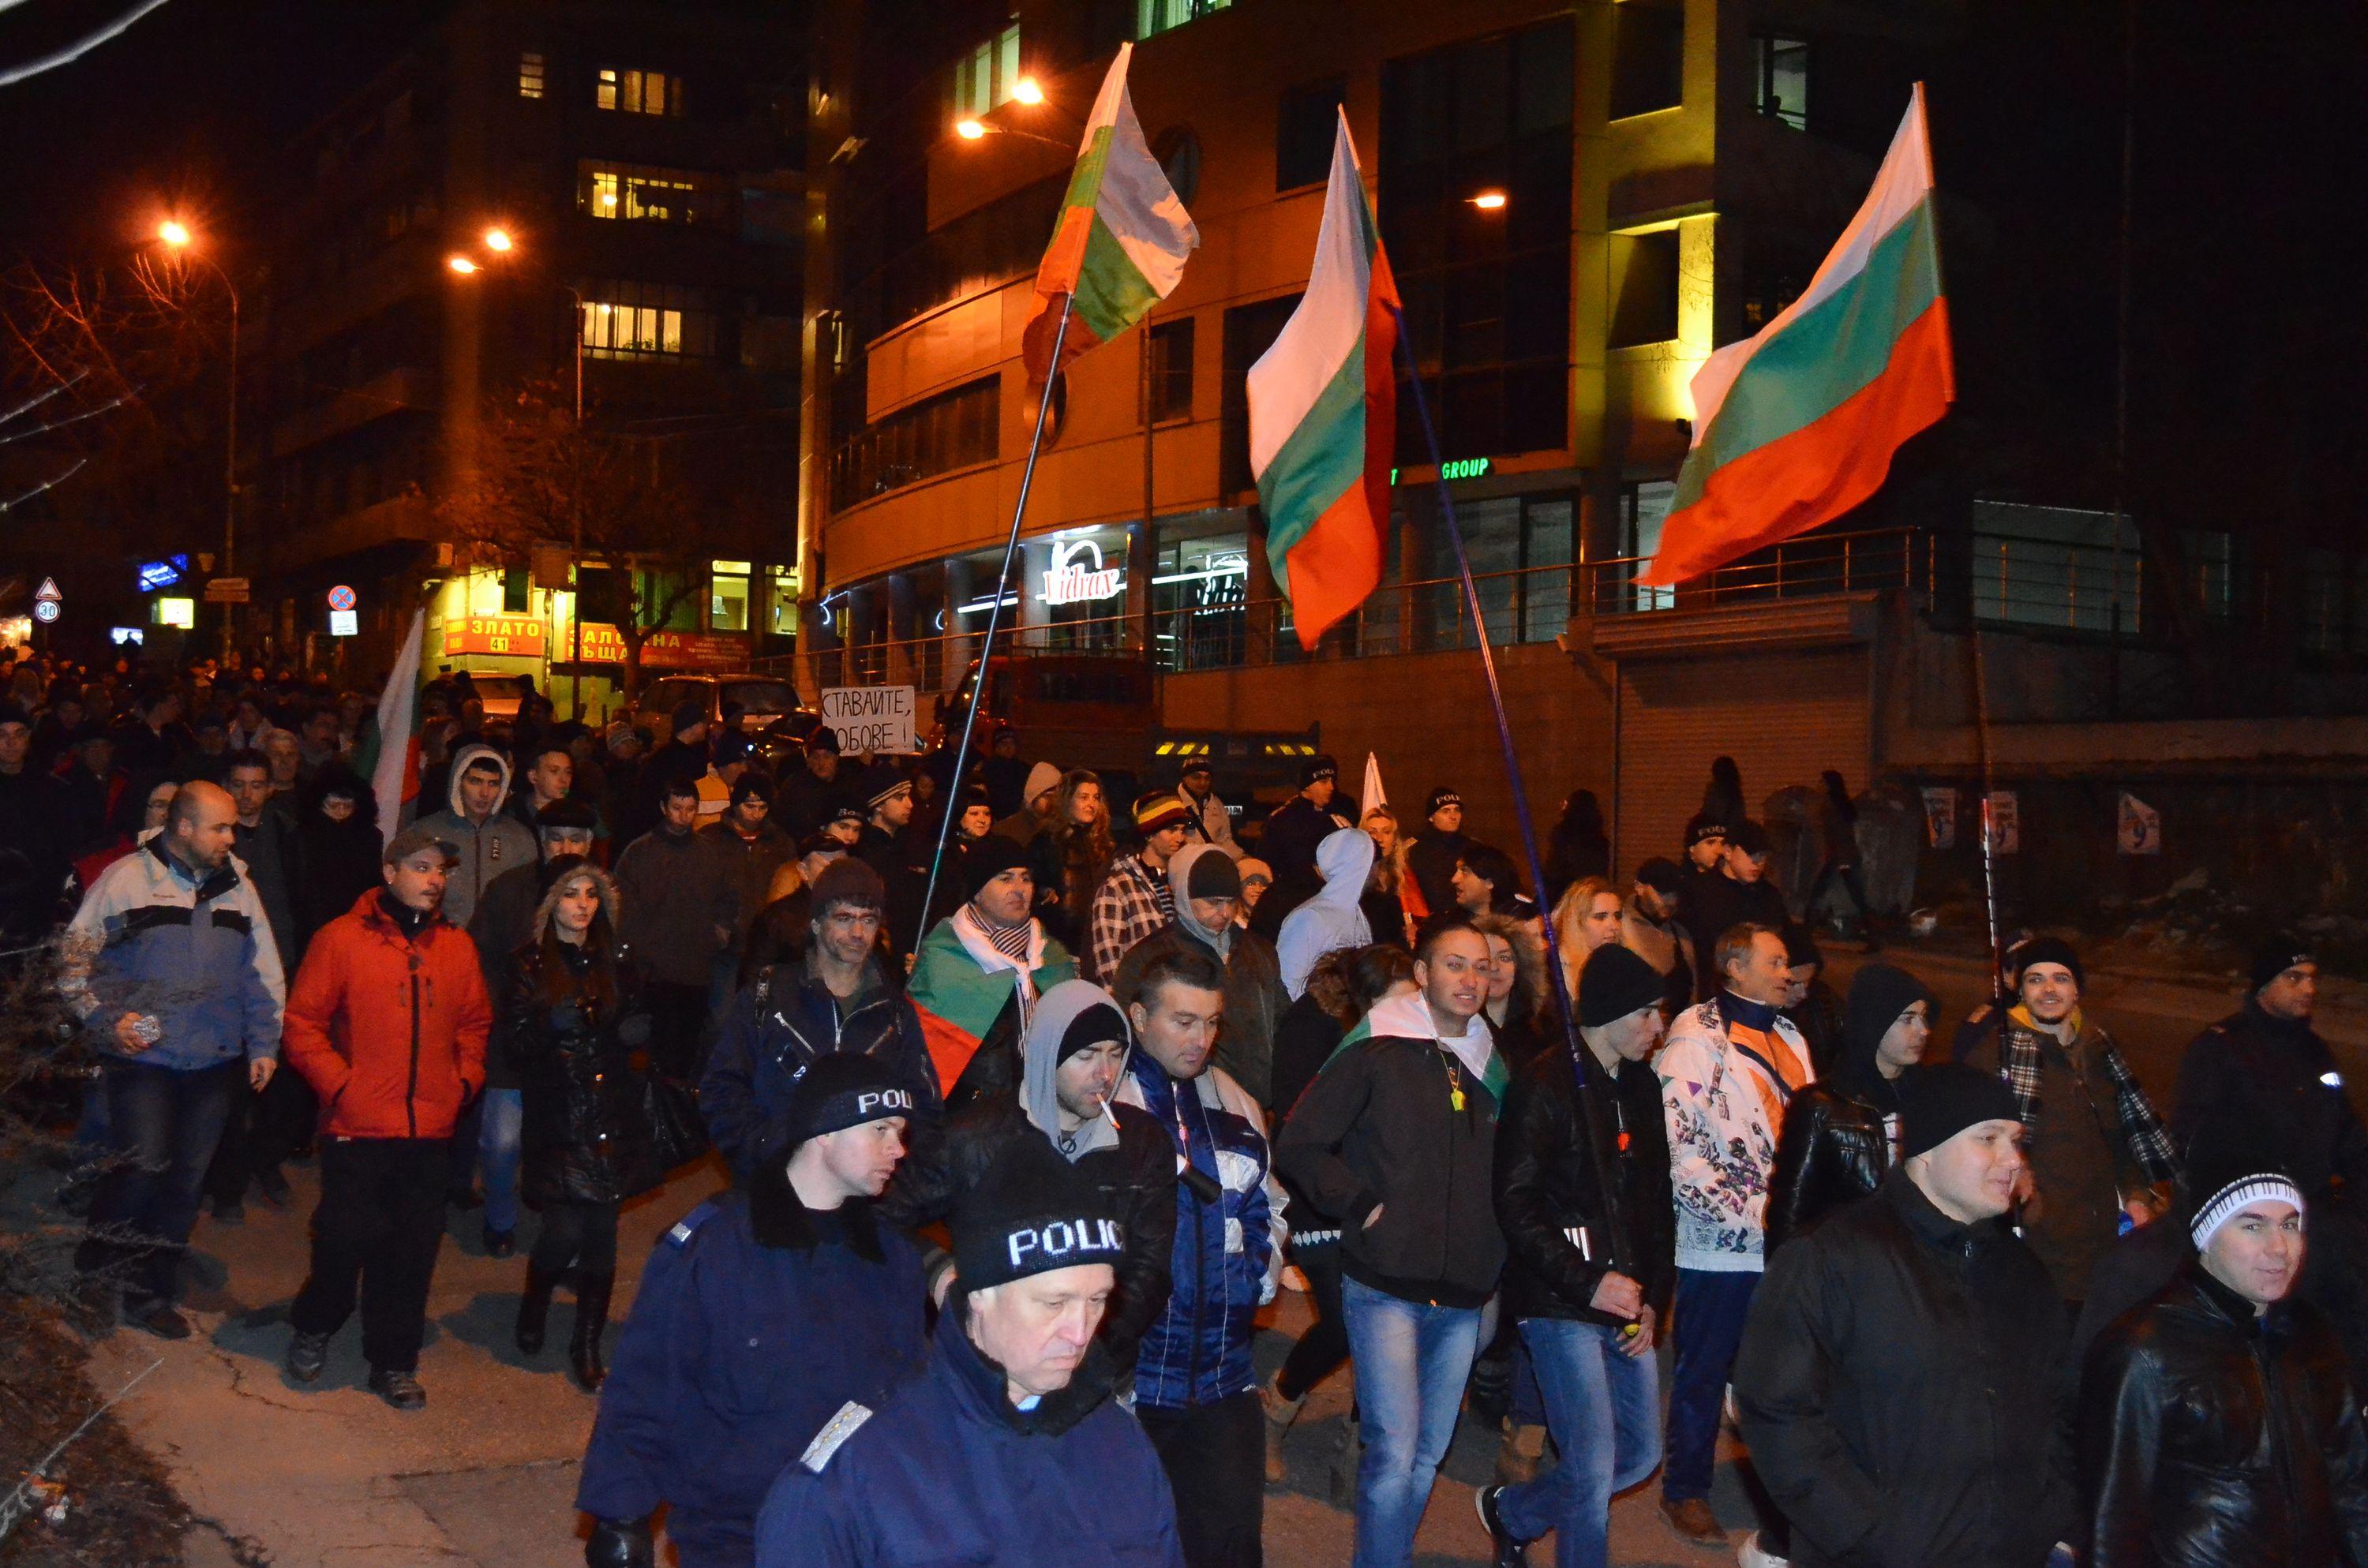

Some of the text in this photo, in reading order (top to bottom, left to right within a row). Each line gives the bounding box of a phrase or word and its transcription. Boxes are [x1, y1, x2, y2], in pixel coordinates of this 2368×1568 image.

[1441, 457, 1489, 480] GROUP
[40, 604, 56, 617] 30
[471, 619, 540, 637] ЗЛАТО
[568, 628, 681, 648] АЛОНА
[492, 638, 507, 651] 41
[822, 689, 912, 717] СТАВАЙТЕ,
[836, 722, 894, 751] ОБОВЕ
